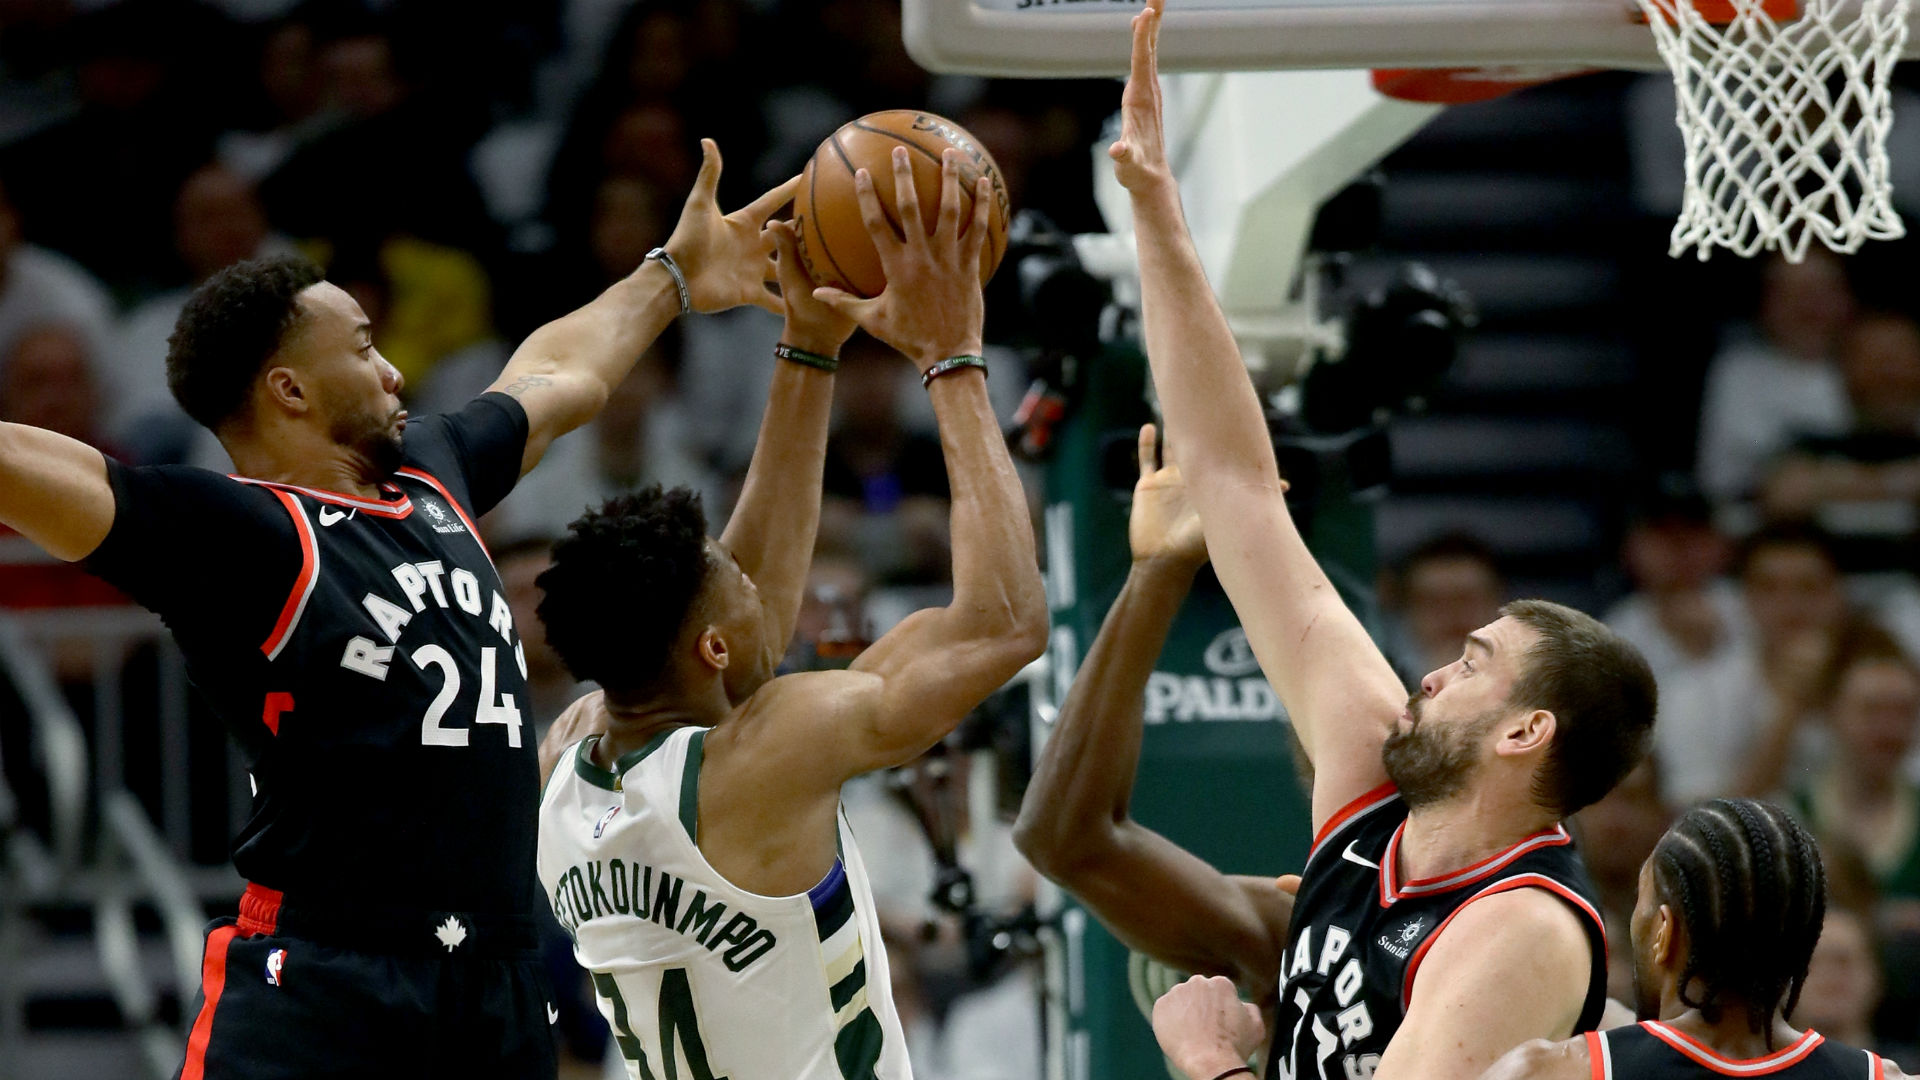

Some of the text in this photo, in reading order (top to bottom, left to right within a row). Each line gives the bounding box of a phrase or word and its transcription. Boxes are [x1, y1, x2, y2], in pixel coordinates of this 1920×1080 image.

[411, 644, 522, 748] 24
[1144, 671, 1288, 724] PALD
[1378, 935, 1397, 954] Sun
